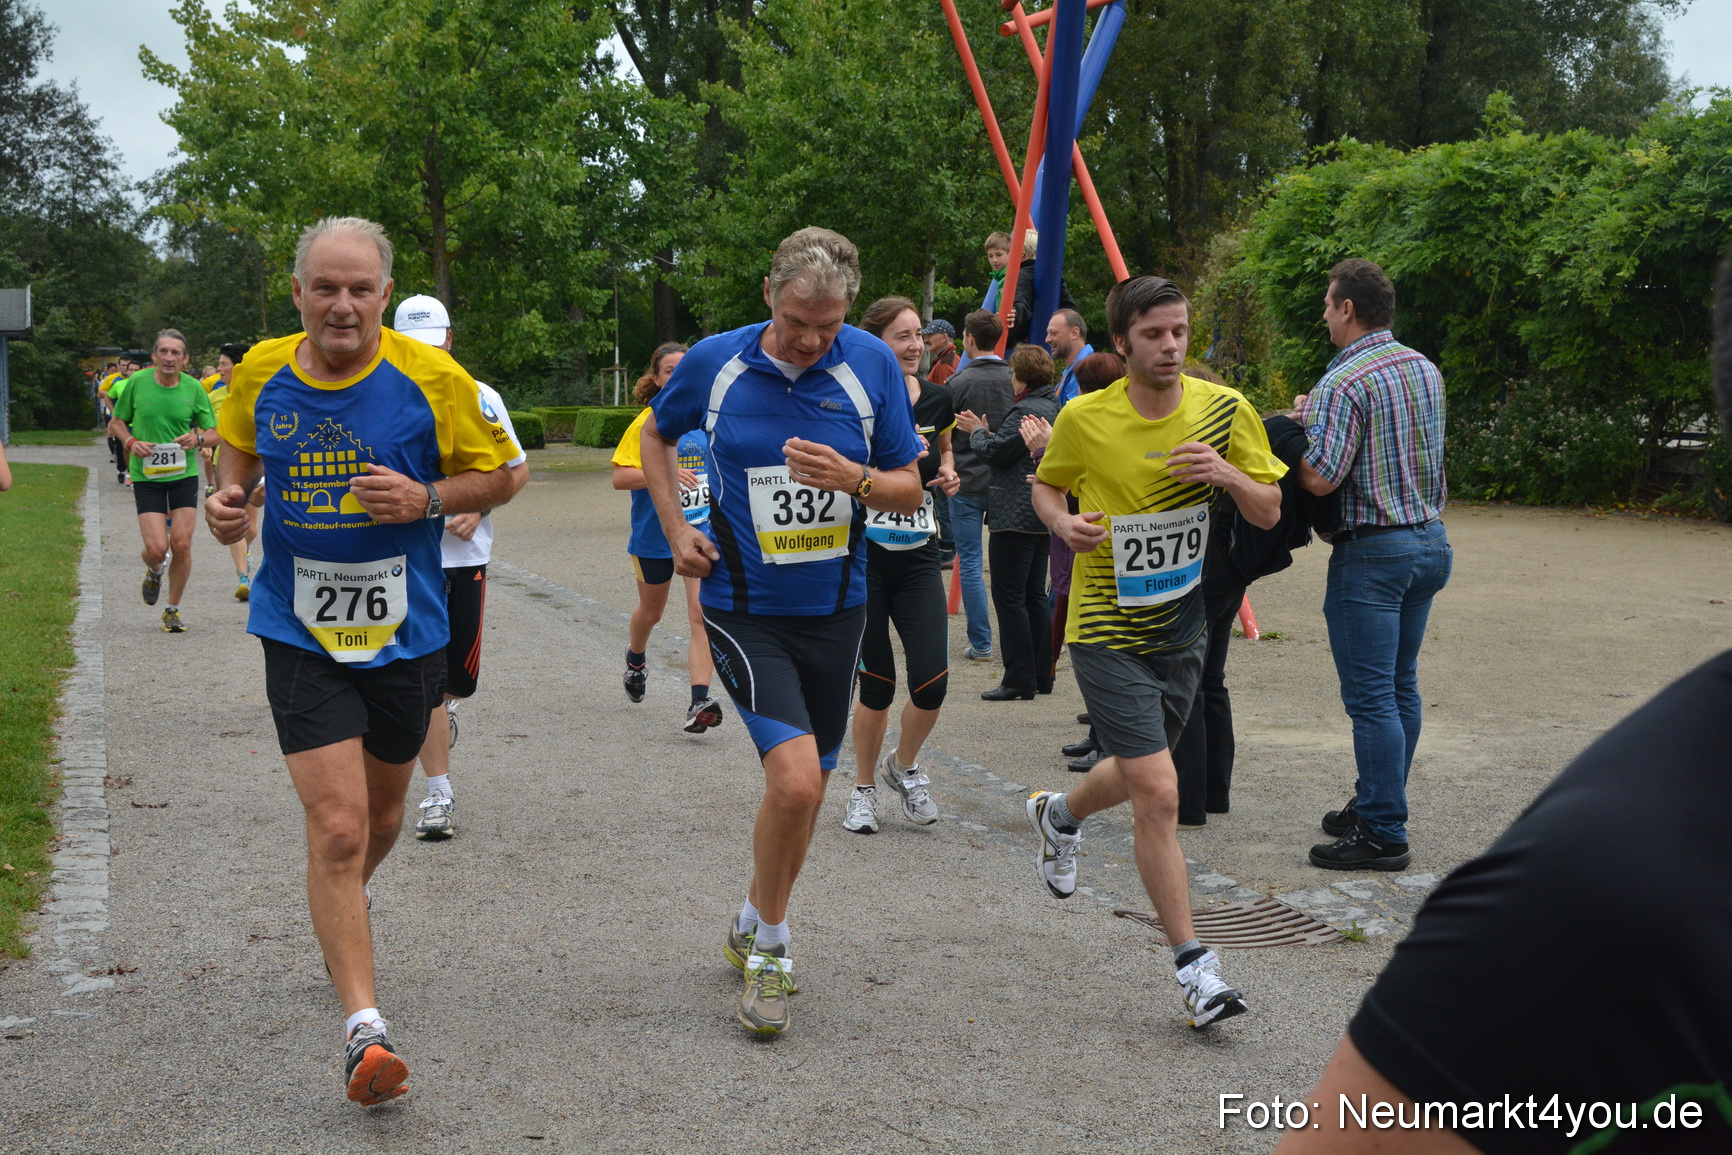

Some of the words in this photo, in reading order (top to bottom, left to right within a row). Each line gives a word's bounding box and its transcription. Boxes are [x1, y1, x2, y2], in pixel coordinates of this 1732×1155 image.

[491, 427, 506, 438] PA
[495, 435, 510, 444] Neu
[151, 452, 176, 465] 281
[751, 476, 786, 487] PARTL
[681, 486, 710, 508] 379
[684, 507, 703, 520] aniela
[772, 489, 835, 526] 332
[872, 507, 929, 529] 2448
[1113, 524, 1147, 534] PARTL
[1150, 516, 1195, 531] Neumarkt
[774, 535, 834, 550] Wolfgang
[888, 532, 911, 543] Ruth
[1124, 527, 1202, 572] 2579
[297, 567, 331, 581] PARTL
[334, 570, 387, 582] Neumarkt
[1145, 574, 1187, 592] Florian
[315, 586, 388, 622] 276
[335, 631, 368, 647] Toni
